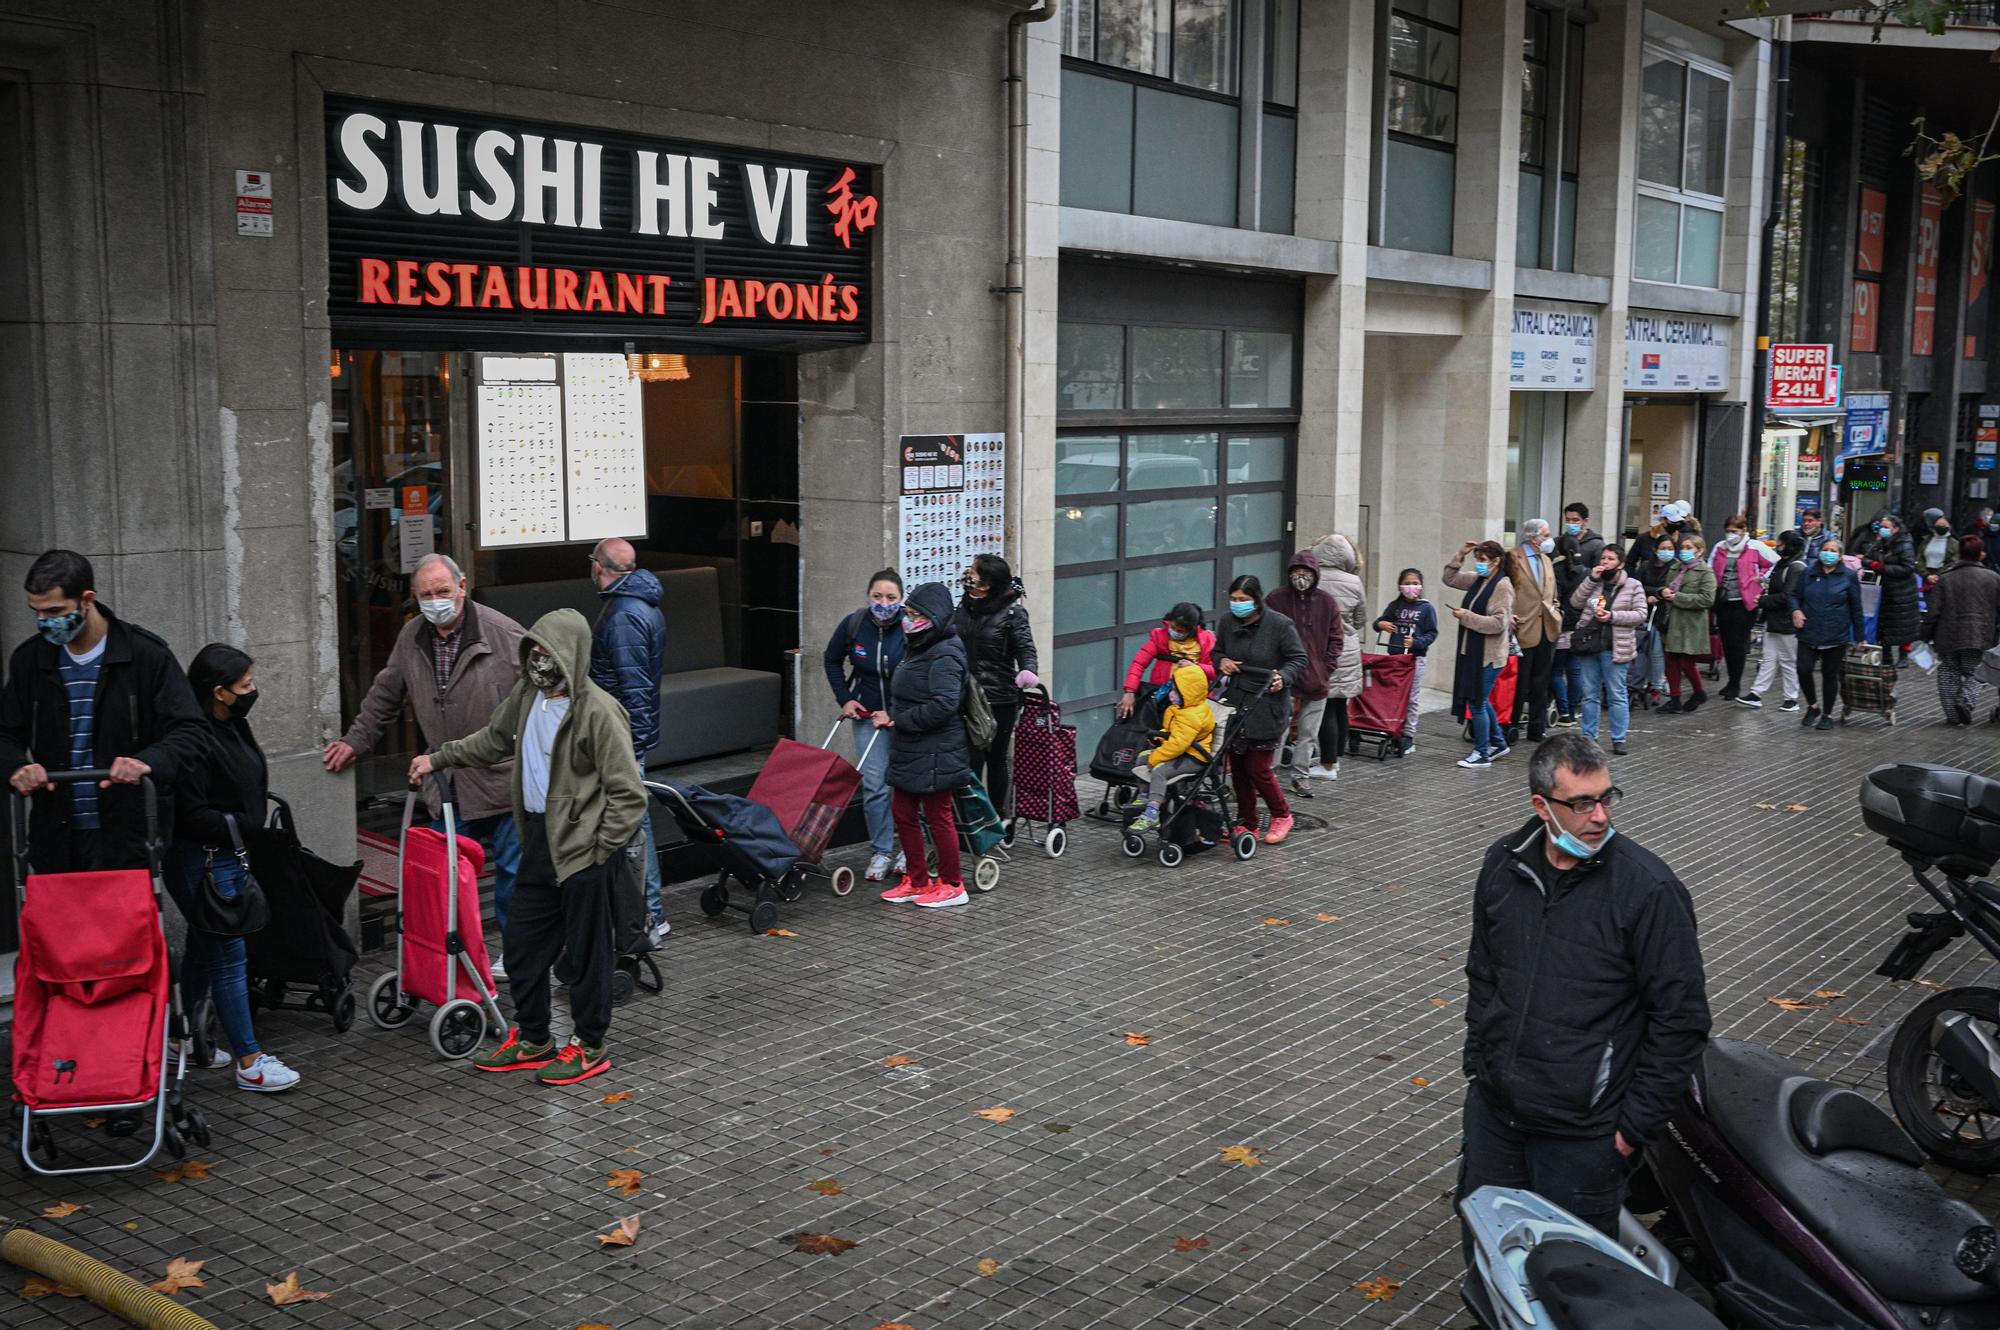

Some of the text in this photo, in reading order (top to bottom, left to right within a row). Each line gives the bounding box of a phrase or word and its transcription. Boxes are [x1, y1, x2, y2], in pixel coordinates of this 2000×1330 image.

[336, 112, 809, 248] SUSHI HE VI
[239, 199, 272, 209] Alarma
[825, 167, 879, 249] 和
[359, 257, 859, 326] RESTAURANT JAPONÉS
[1548, 314, 1594, 337] CERAMICA
[1665, 320, 1713, 345] CERAMICA
[1775, 348, 1825, 364] SUPER
[1774, 365, 1825, 381] MERCAT
[1776, 382, 1820, 397] 24H.
